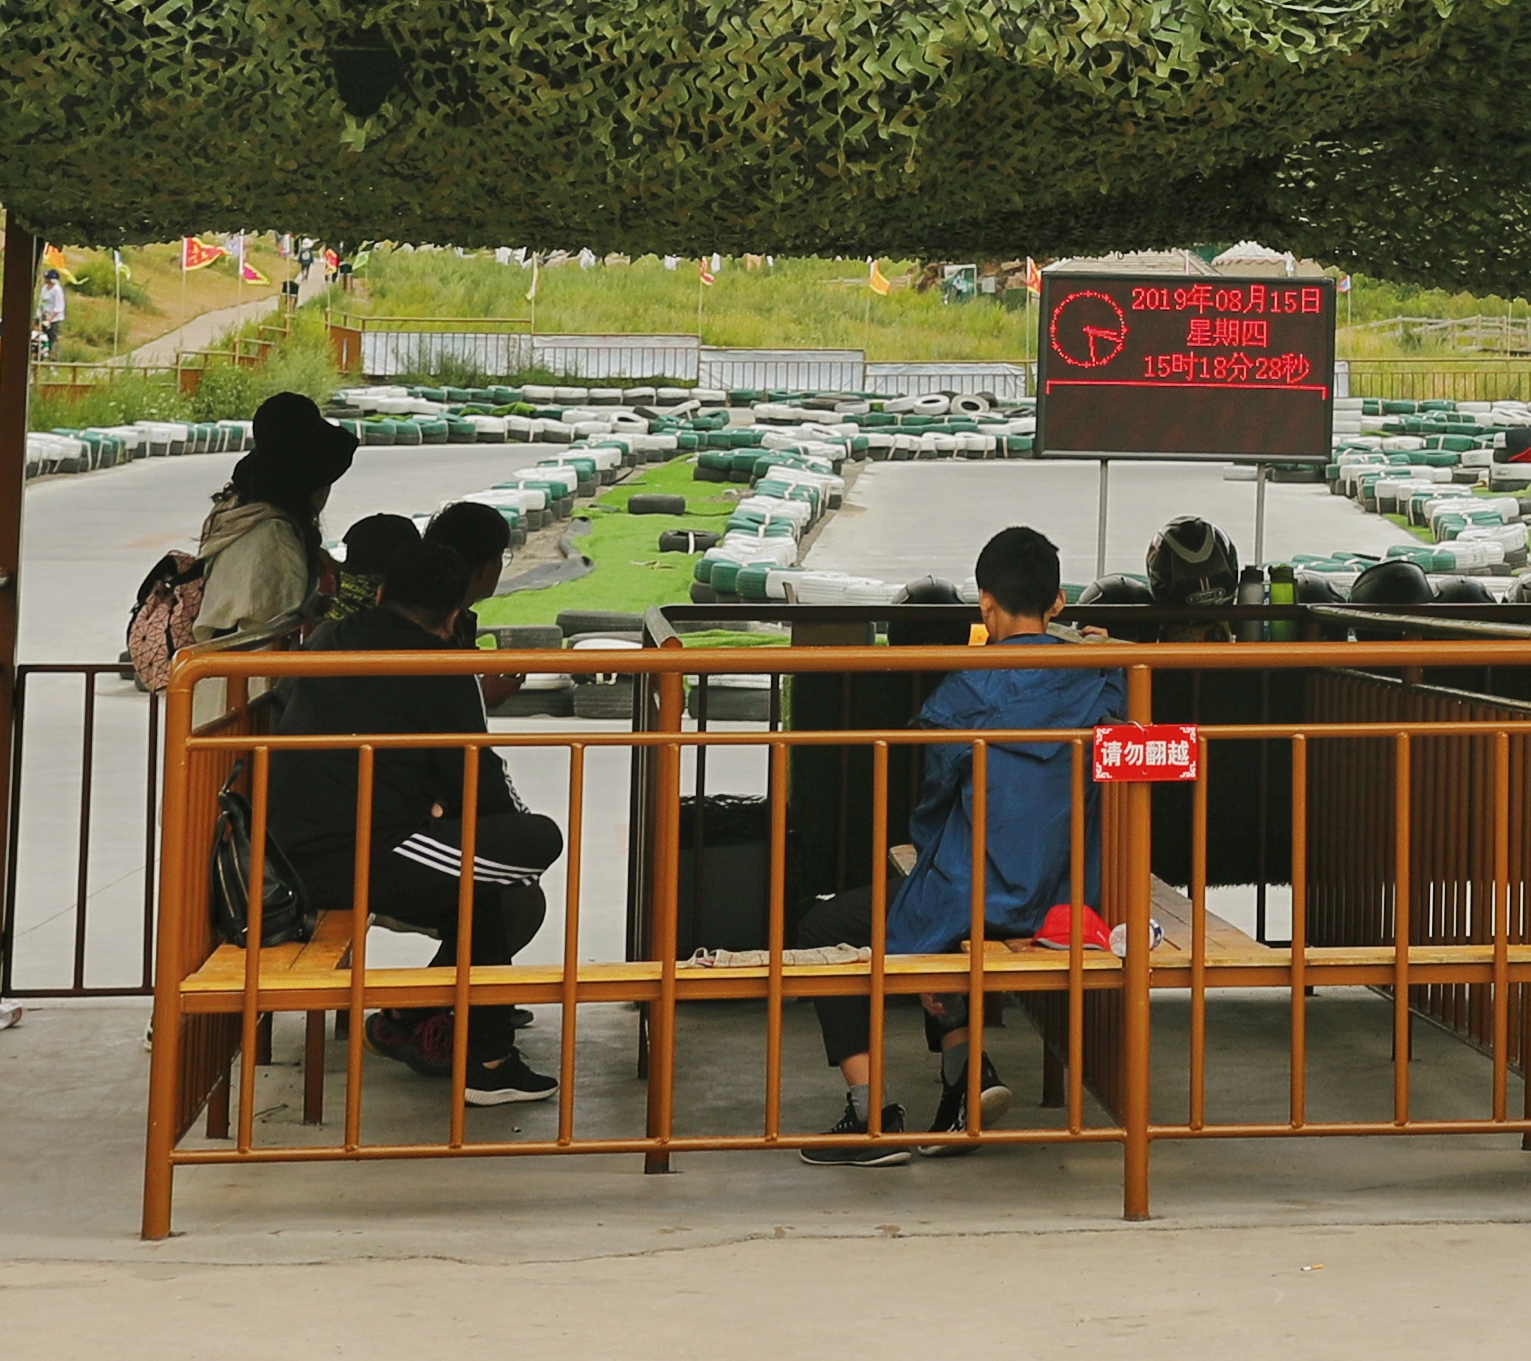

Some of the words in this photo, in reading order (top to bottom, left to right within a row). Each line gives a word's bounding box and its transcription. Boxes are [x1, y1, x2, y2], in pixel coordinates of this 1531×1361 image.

[1131, 284, 1322, 314] 2019年08月15日
[1186, 318, 1269, 348] 星期四
[1143, 352, 1311, 384] 15时18分28秒
[1100, 740, 1190, 767] 请勿翻越
